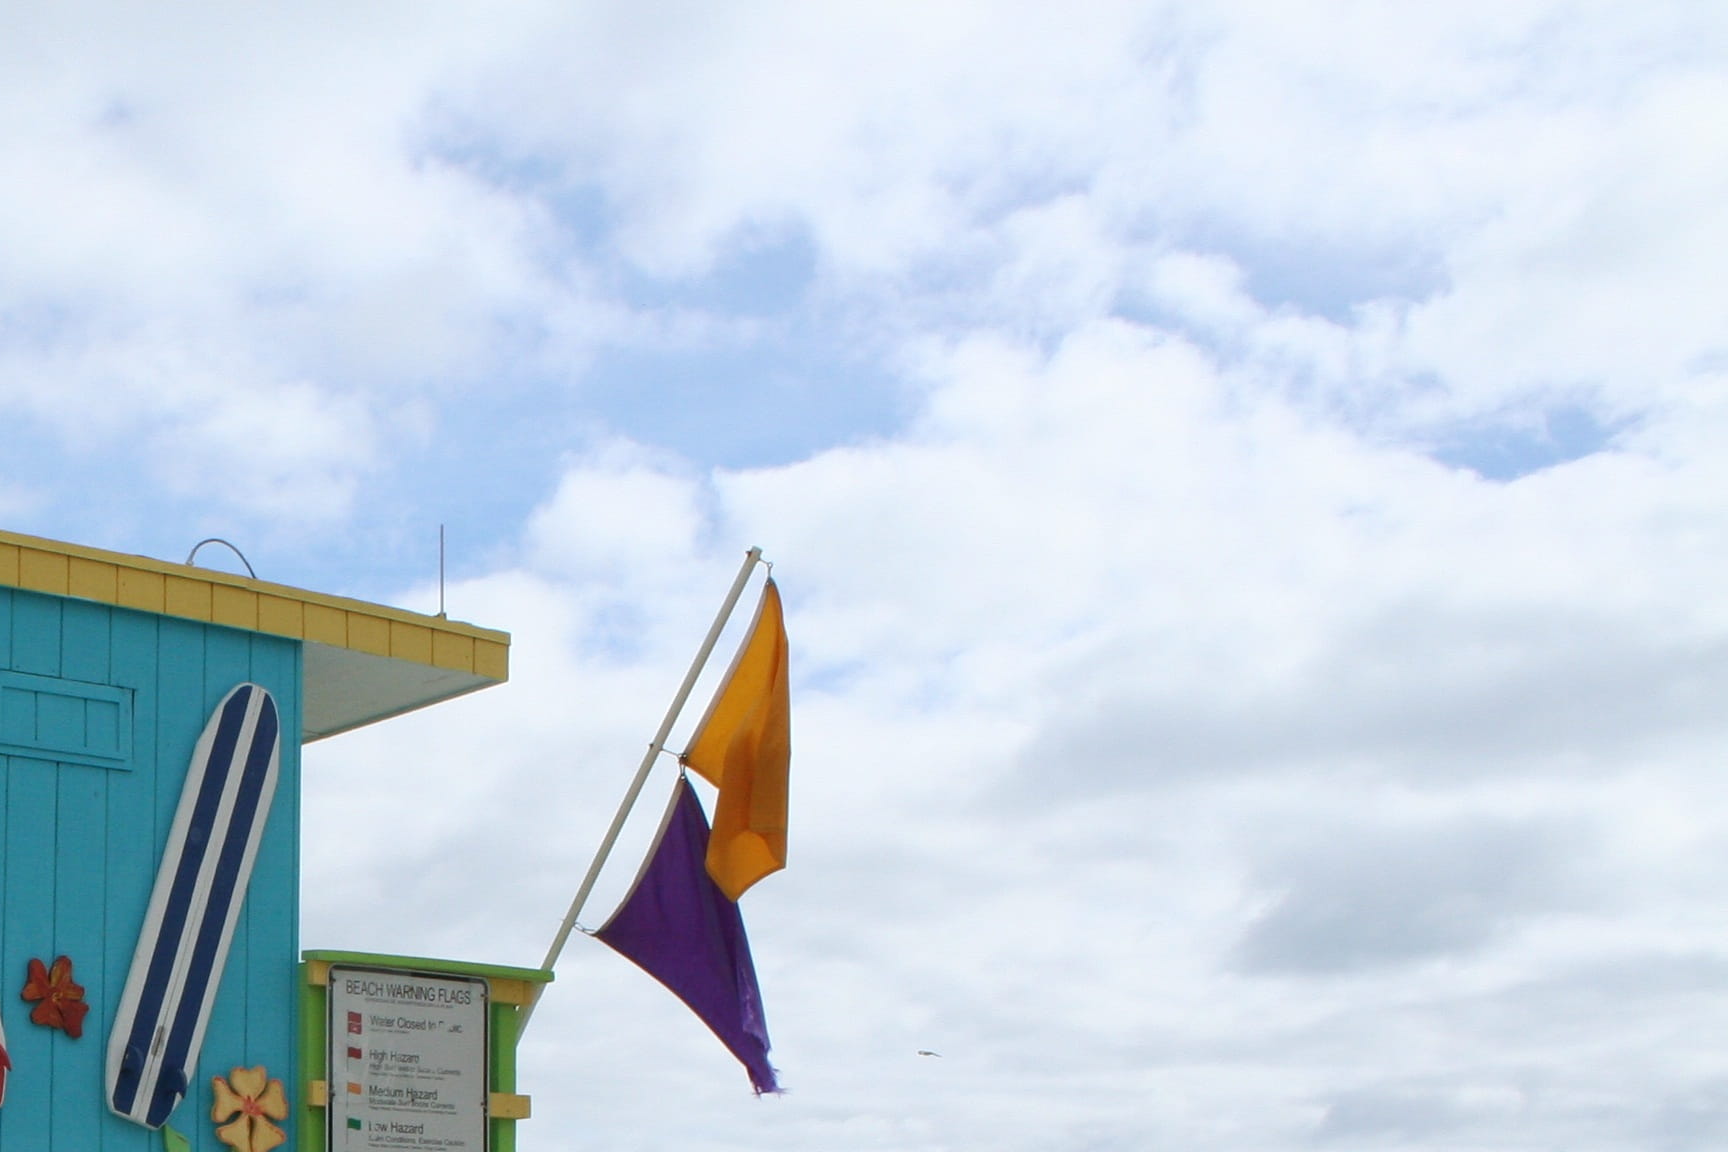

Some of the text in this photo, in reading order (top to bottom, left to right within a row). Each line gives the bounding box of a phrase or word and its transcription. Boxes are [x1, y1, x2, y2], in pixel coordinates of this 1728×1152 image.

[346, 979, 384, 997] BEACH
[386, 982, 436, 1002] WARNING
[438, 987, 472, 1006] FLAGS
[370, 1015, 395, 1028] Water
[397, 1017, 426, 1031] Closed
[369, 1049, 420, 1065] High Hazard
[368, 1085, 439, 1100] Medium Hazard
[390, 1121, 424, 1135] Hazard
